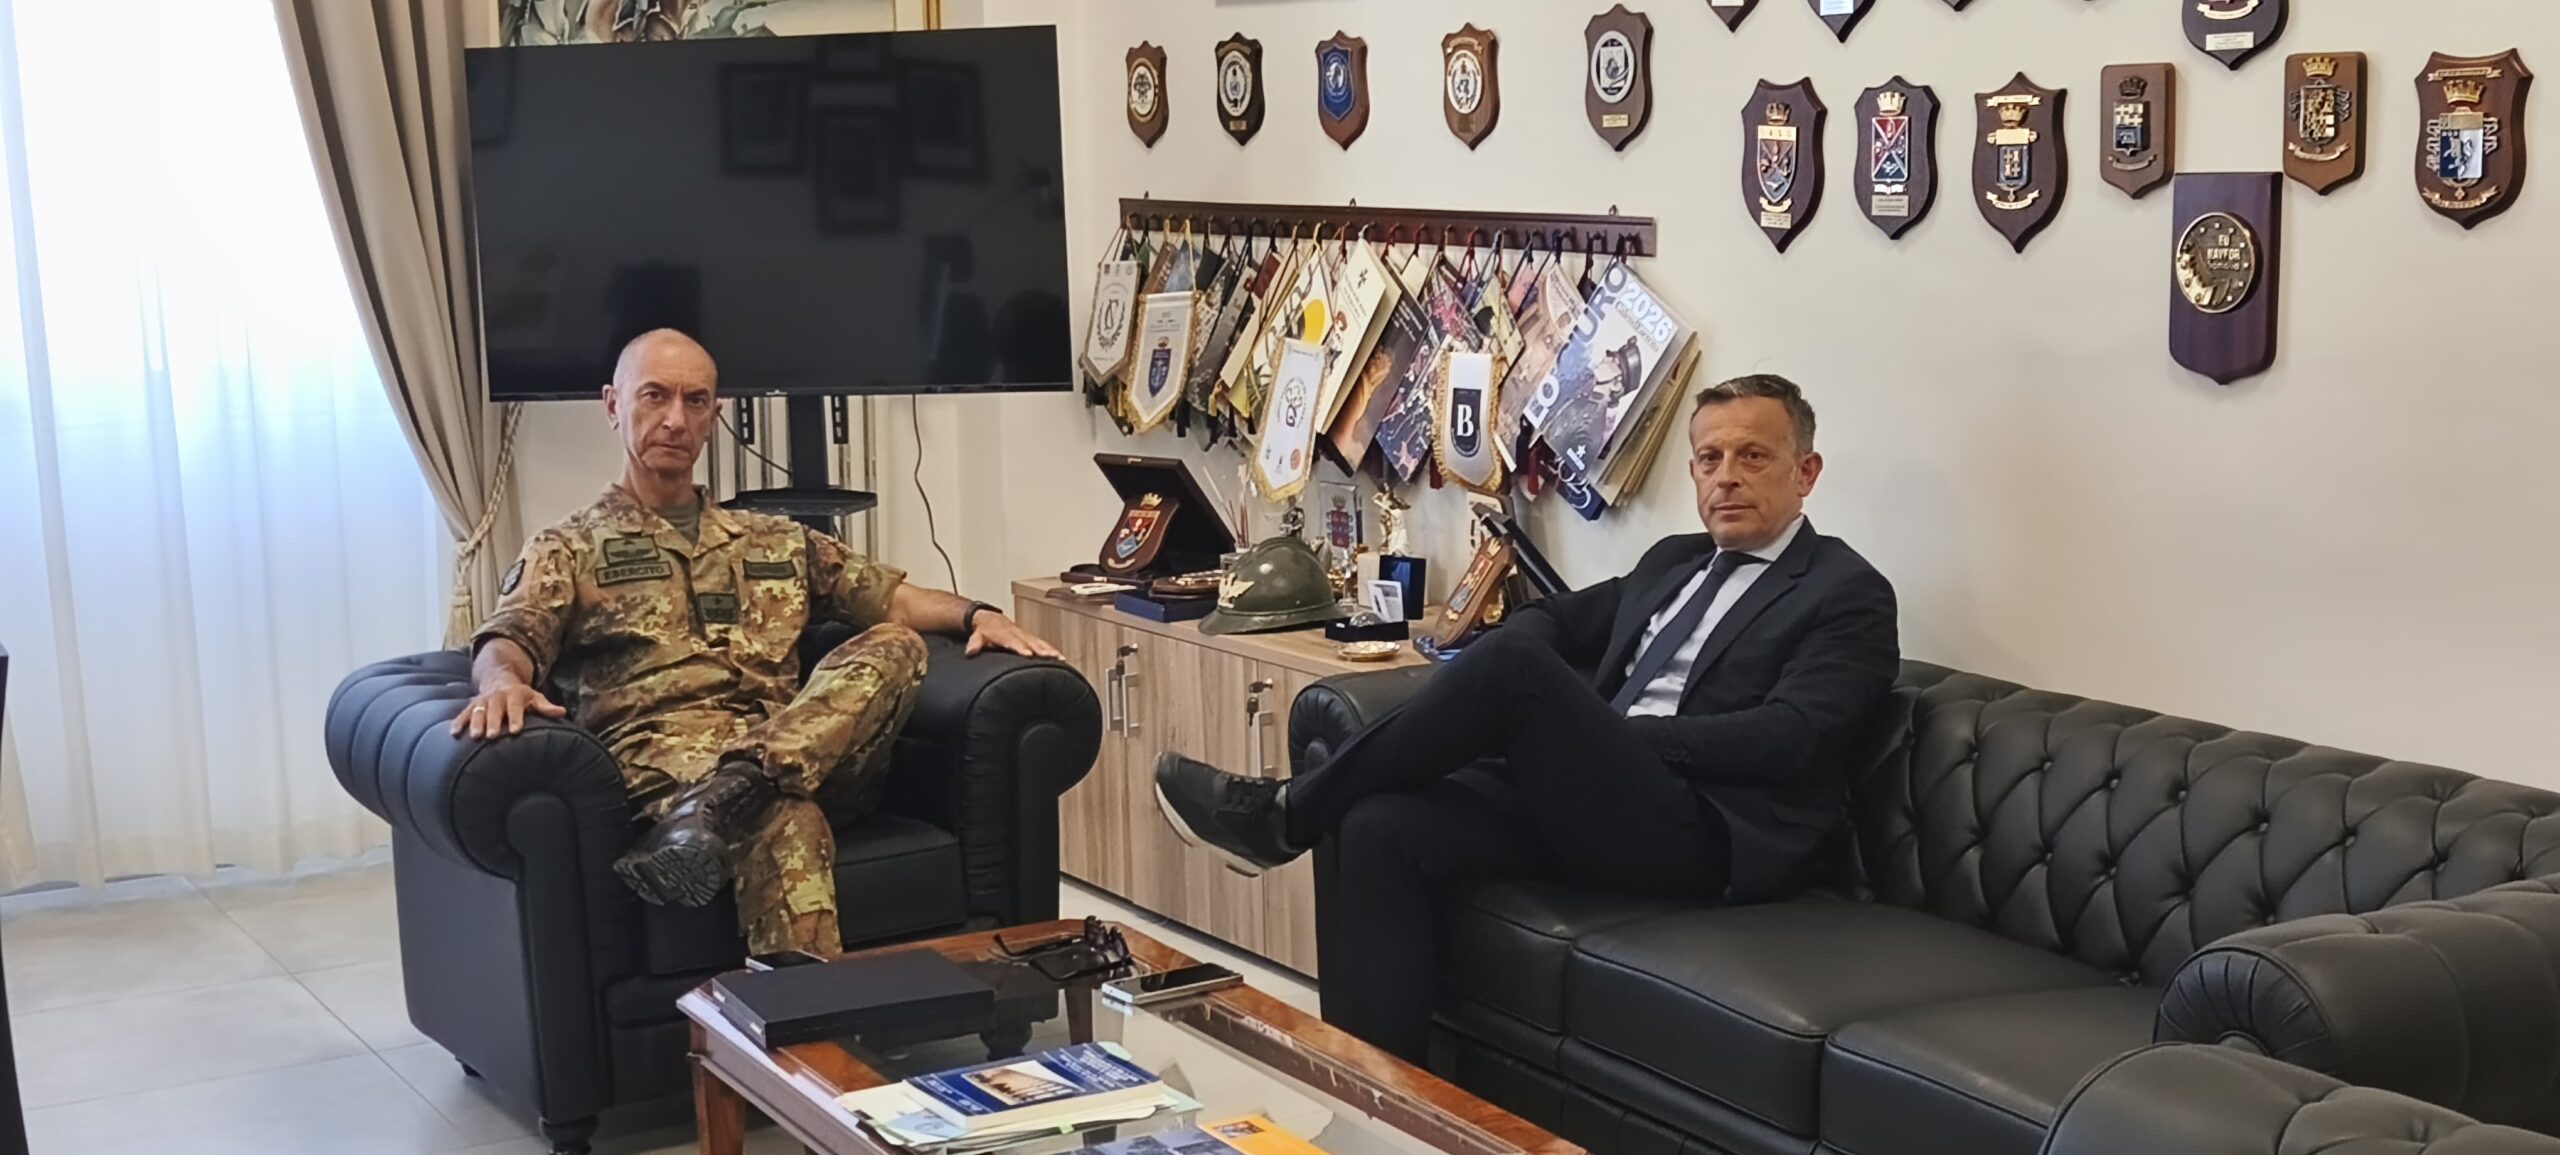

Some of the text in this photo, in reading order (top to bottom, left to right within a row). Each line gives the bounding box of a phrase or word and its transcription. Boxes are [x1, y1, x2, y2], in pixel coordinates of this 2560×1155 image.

[2218, 234, 2231, 246] EU
[1621, 280, 1675, 343] 2026
[1523, 374, 1560, 429] LO
[1456, 403, 1475, 437] B
[604, 565, 666, 580] ESERCITO
